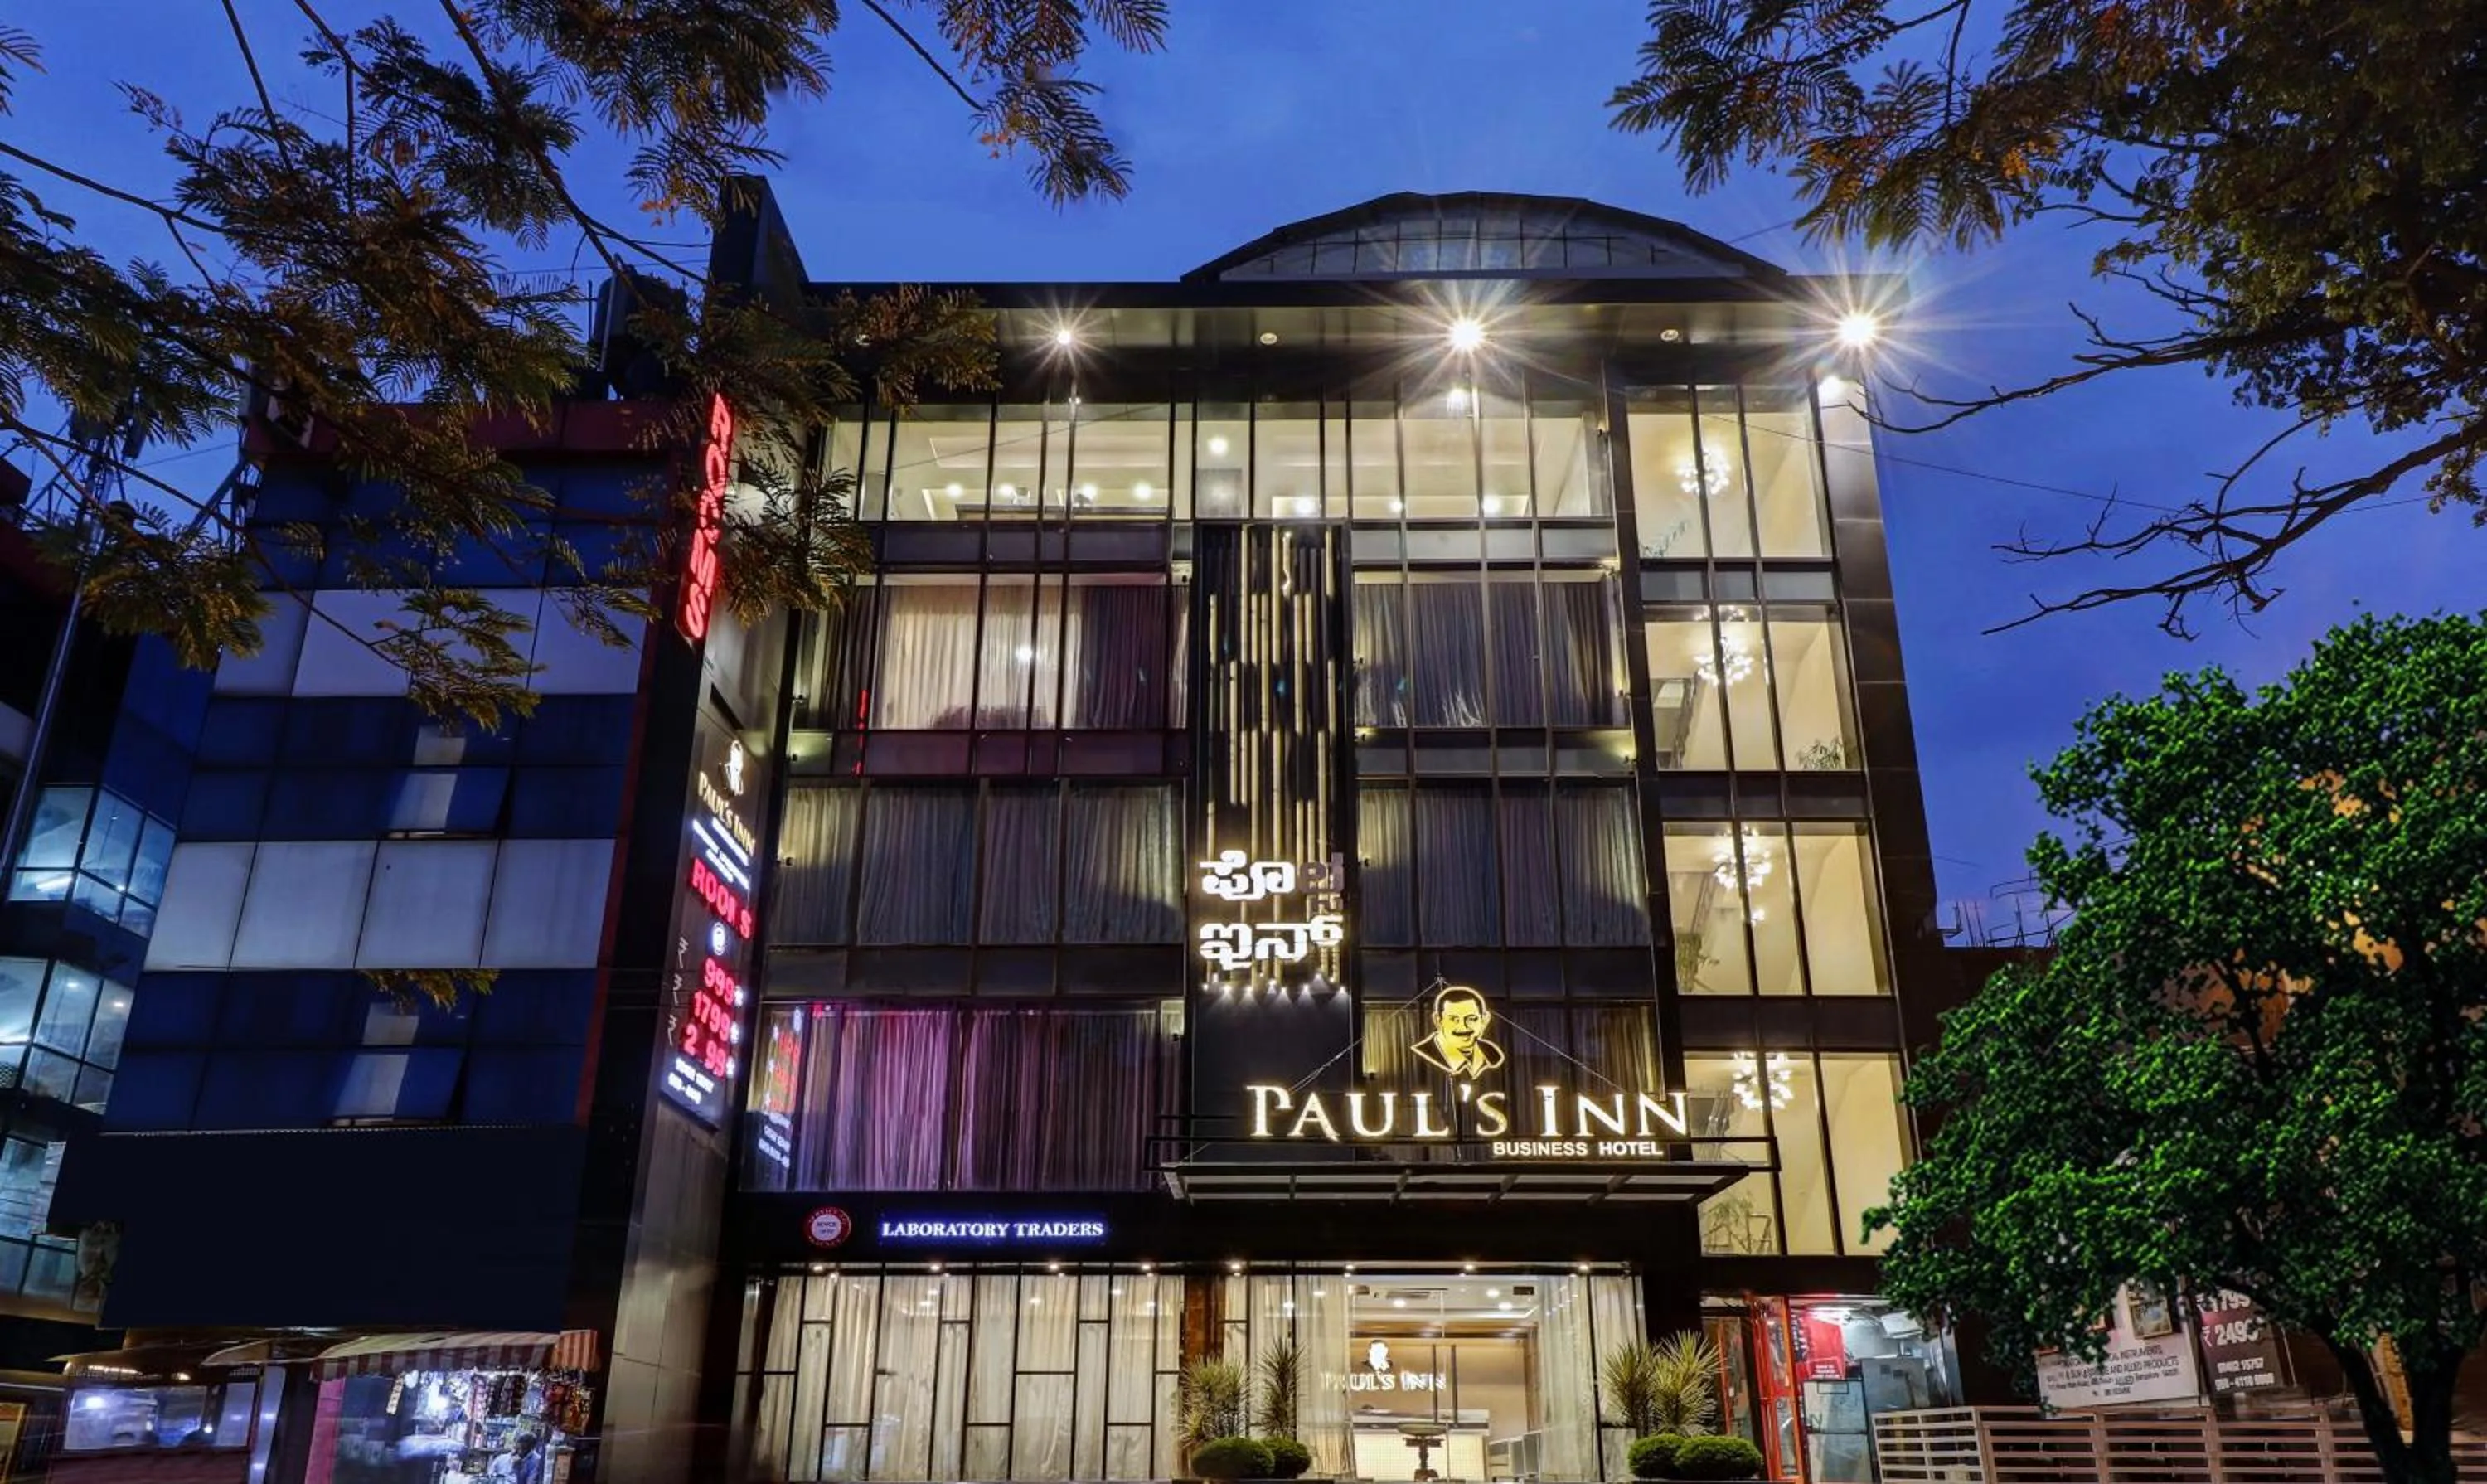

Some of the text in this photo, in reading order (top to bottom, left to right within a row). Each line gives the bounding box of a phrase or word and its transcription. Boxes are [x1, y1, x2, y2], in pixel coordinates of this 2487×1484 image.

[699, 770, 734, 828] PAUL'S
[684, 1022, 726, 1077] 299
[1246, 1083, 1689, 1142] PAUL'S INN
[1493, 1141, 1664, 1157] BUSINESS HOTEL
[882, 1221, 1104, 1238] LABORATORY TRADERS
